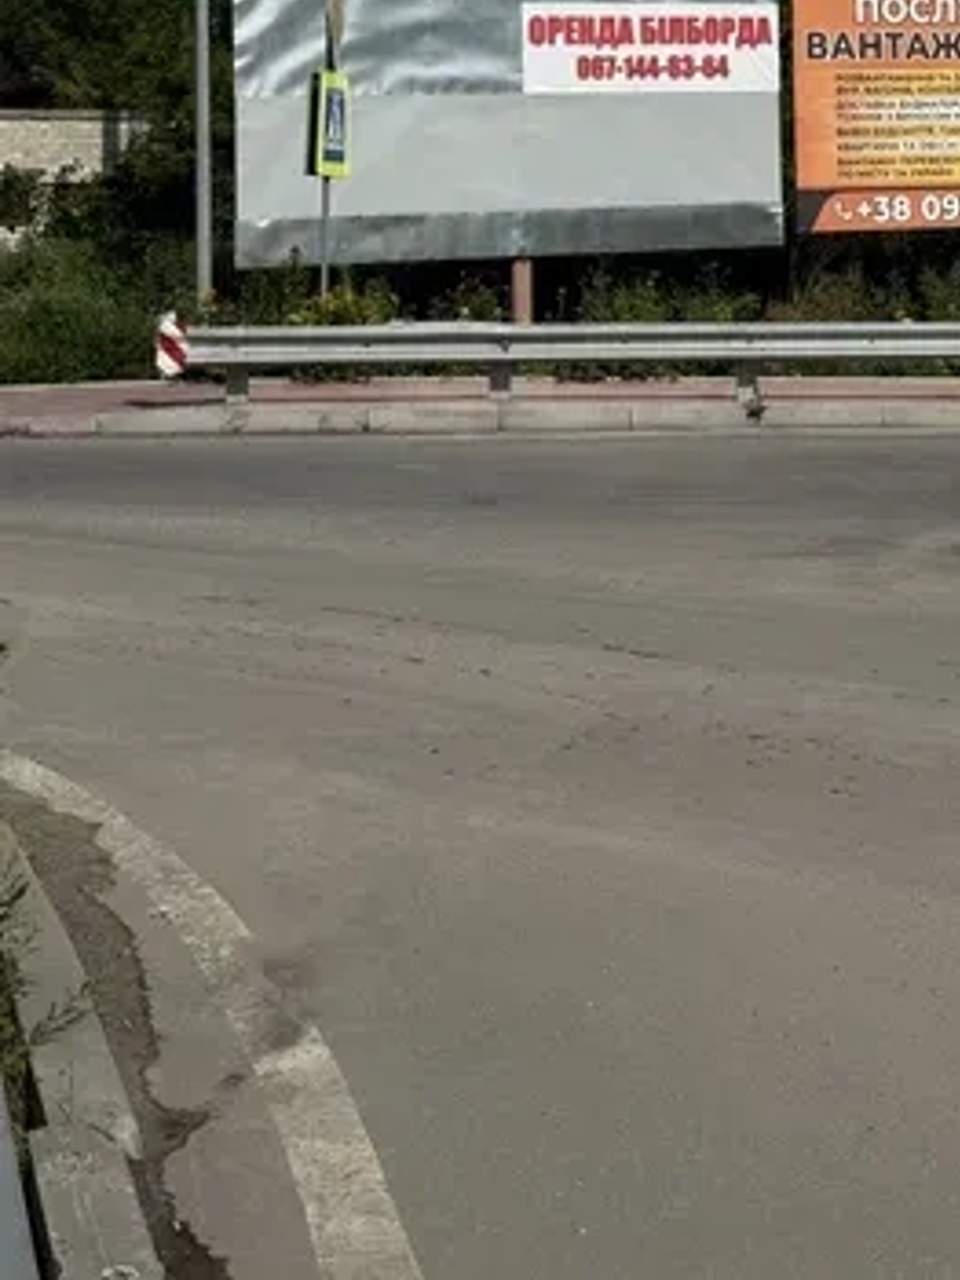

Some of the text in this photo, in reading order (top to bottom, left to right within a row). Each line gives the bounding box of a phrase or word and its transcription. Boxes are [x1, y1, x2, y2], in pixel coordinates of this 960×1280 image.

[528, 15, 772, 49] ОРЕНДА БІЛБОРДА
[856, 197, 911, 220] +38
